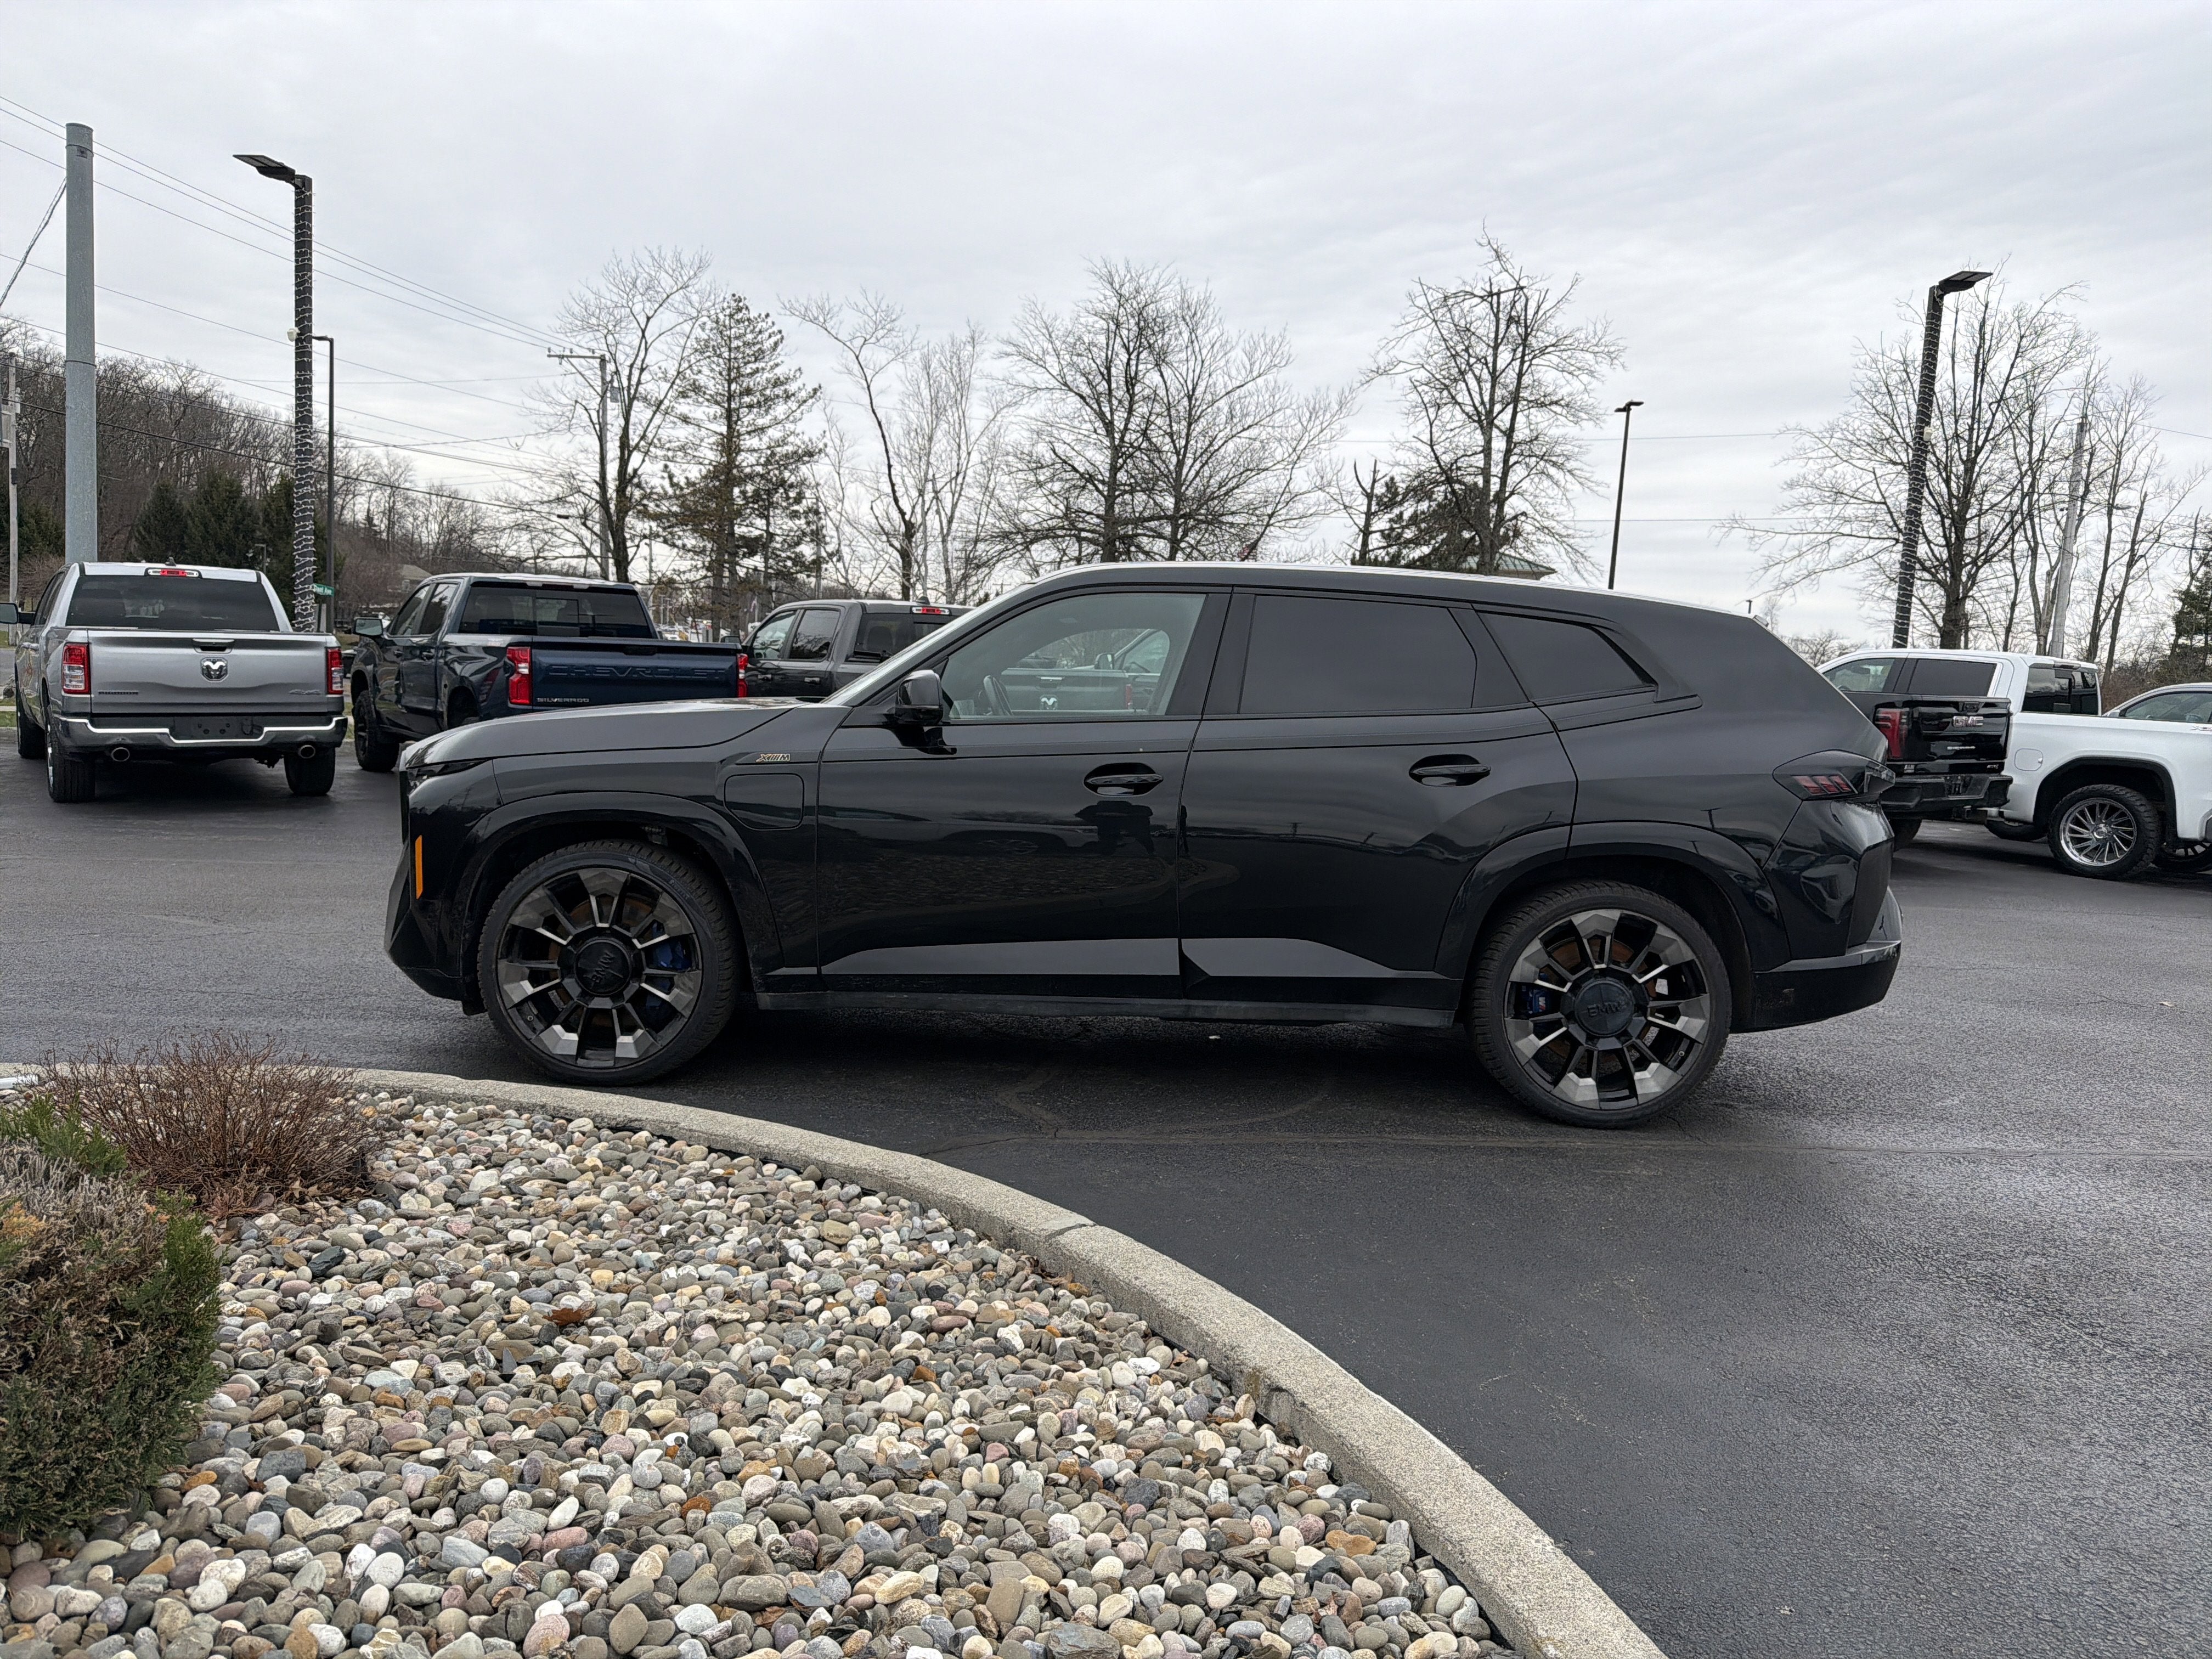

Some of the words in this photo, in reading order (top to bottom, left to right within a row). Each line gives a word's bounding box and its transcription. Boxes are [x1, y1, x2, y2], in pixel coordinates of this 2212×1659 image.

[549, 665, 725, 679] CHEVROLET
[1953, 715, 1984, 727] GMC
[1587, 1001, 1623, 1017] BMW
